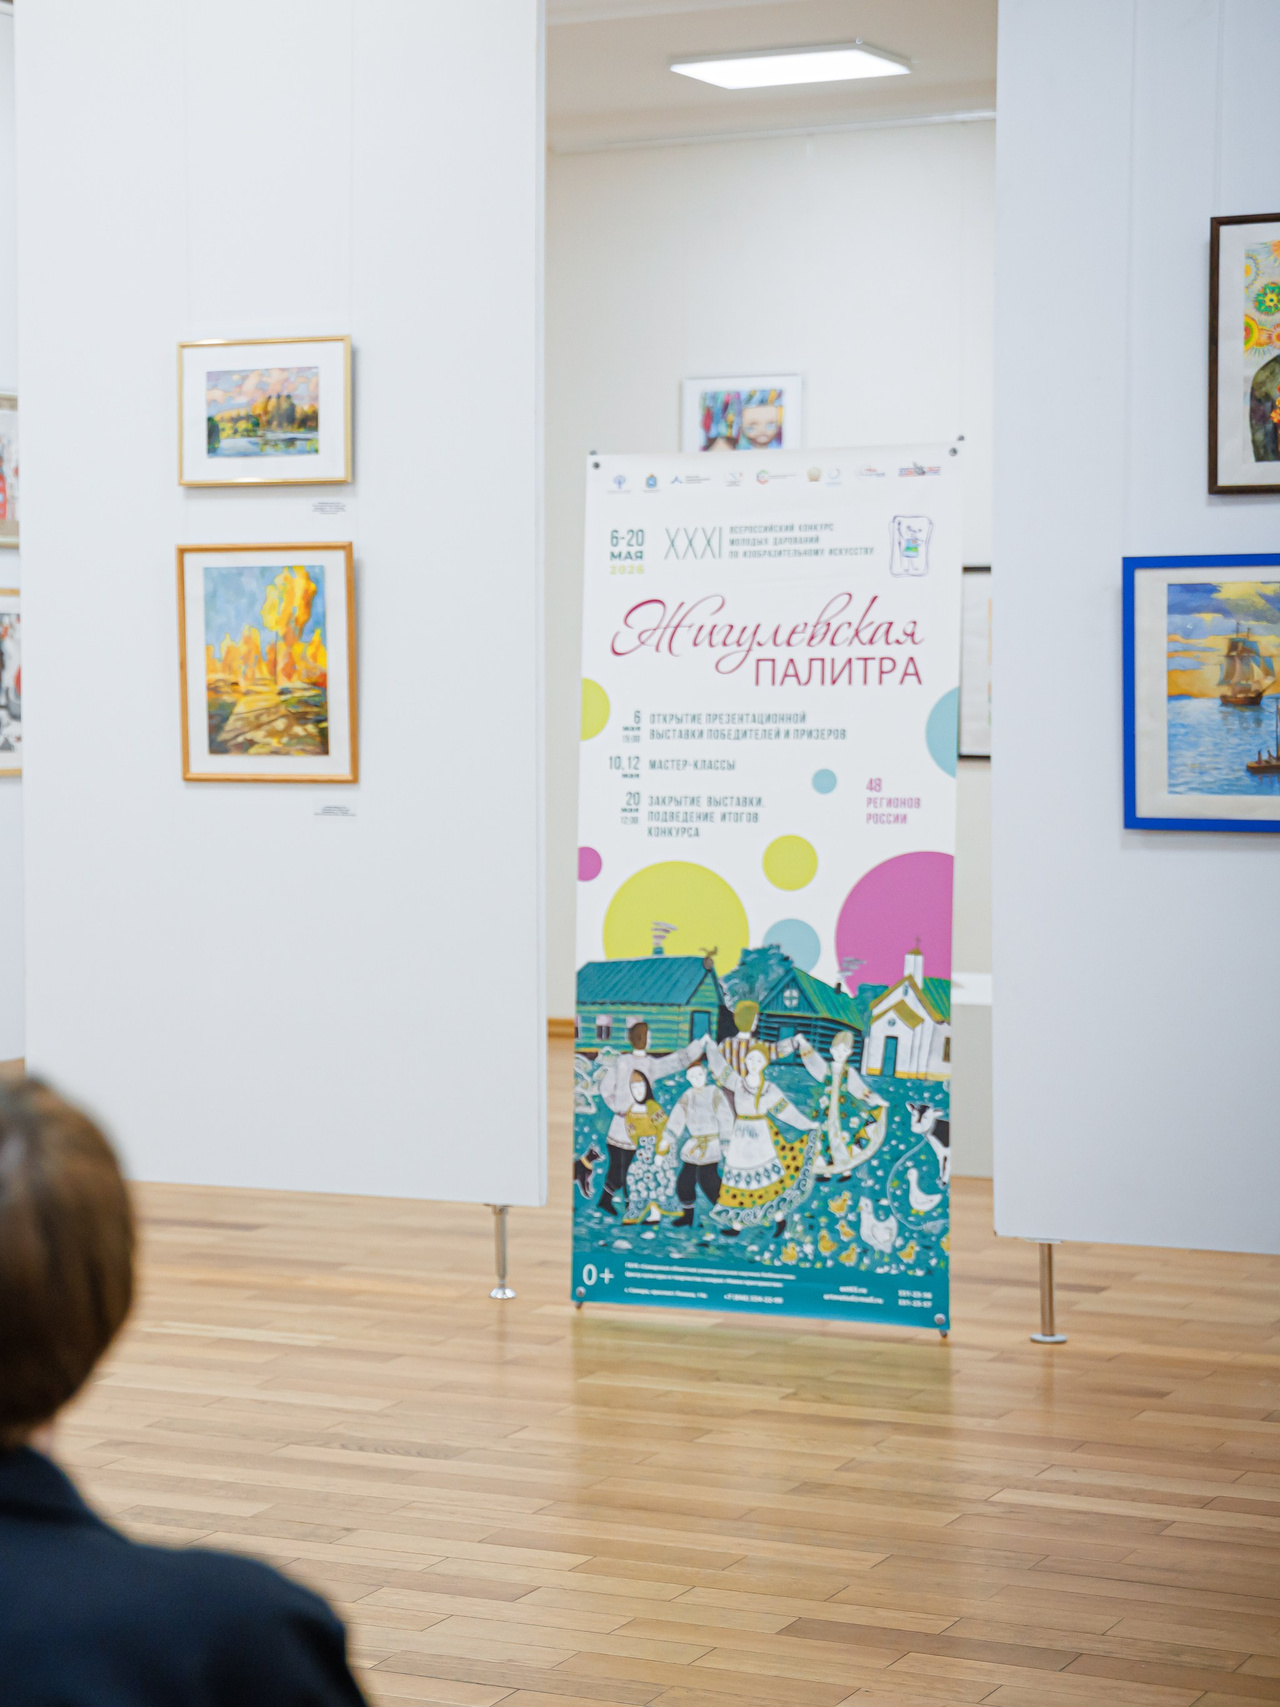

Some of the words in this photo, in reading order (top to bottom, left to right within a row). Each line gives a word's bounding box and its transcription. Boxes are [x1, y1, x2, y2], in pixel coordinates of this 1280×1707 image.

[798, 523, 834, 532] КОНКУРС
[610, 529, 645, 547] 6-20
[664, 526, 723, 560] XXXI
[729, 538, 768, 546] МОЛОДЫХ
[773, 535, 820, 546] ДАРОВАНИЙ
[610, 550, 643, 561] МАЯ
[729, 550, 739, 559] ПО
[828, 547, 874, 556] ИСКУССТВУ
[610, 592, 923, 676] Жигулевская
[755, 656, 922, 686] ПАЛИТРА
[634, 711, 641, 725] 6
[650, 713, 702, 725] ОТКРЫТИЕ
[706, 711, 806, 725] ПРЕЗЕНТАЦИОННОЙ
[650, 729, 704, 740] ВЫСТАВКИ
[707, 727, 781, 740] ПОБЕДИТЕЛЕЙ
[784, 729, 790, 739] И
[649, 759, 735, 771] МАСТЕР-КЛАССЫ
[866, 778, 882, 793] 48
[626, 791, 641, 806] 20
[648, 796, 701, 807] ЗАКРЫТИЕ
[867, 797, 921, 809] РЕГИОНОВ
[648, 811, 715, 823] ПОДВЕДЕНИЕ
[720, 812, 759, 823] ИТОГОВ
[866, 813, 907, 824] РОССИИ
[648, 827, 700, 838] КОНКУРСА
[583, 1263, 615, 1286] 0+
